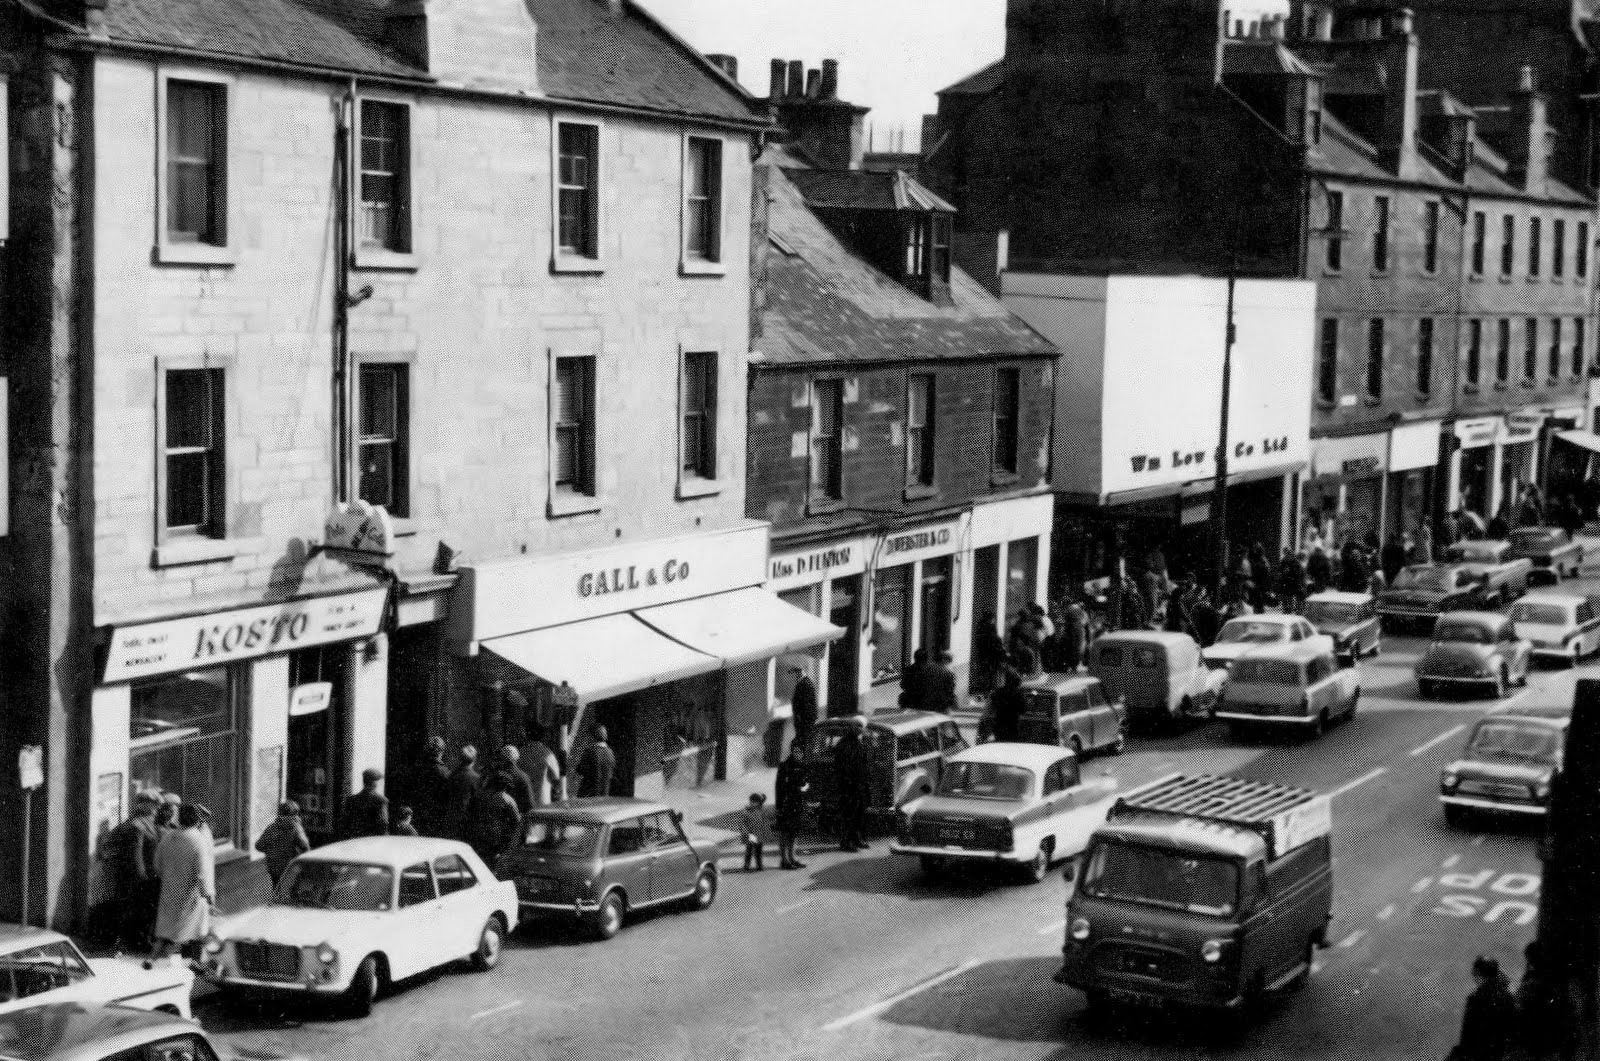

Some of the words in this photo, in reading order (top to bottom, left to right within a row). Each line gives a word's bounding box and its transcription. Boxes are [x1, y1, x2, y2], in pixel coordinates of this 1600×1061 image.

[1171, 450, 1206, 468] Low
[1234, 441, 1254, 458] Co
[1263, 435, 1289, 455] Ltd
[577, 565, 640, 598] GALL
[644, 567, 658, 588] &
[661, 558, 690, 586] Co
[192, 611, 309, 660] KOSTO
